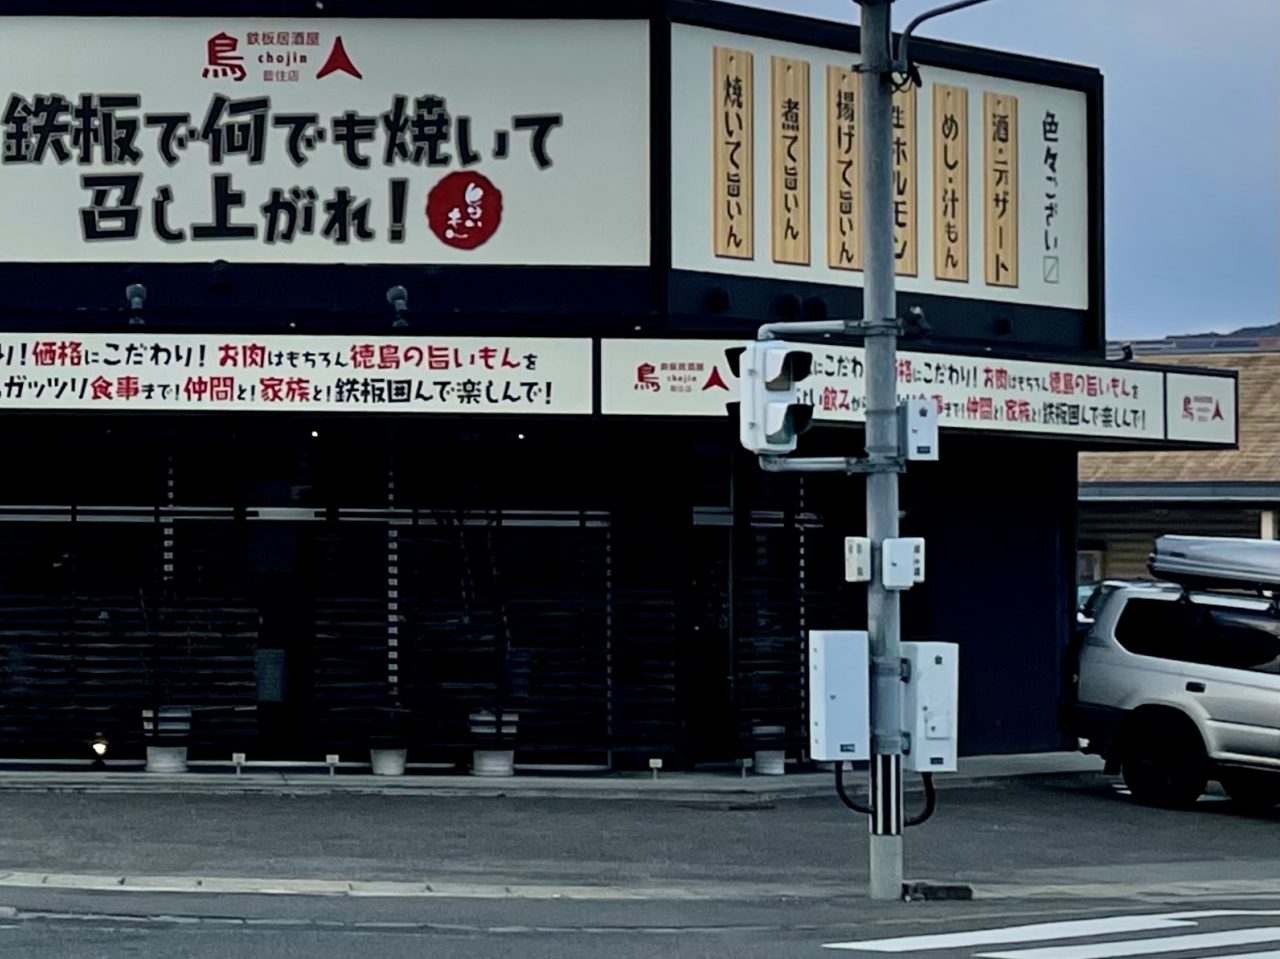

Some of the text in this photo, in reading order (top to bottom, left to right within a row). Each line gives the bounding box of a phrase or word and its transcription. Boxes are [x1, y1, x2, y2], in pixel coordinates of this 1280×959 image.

[246, 32, 320, 46] 鉄板居酒屋
[258, 51, 308, 67] chojin
[2, 93, 563, 169] 鉄板で何でも焼いて
[723, 74, 744, 249] 焼いて旨いん
[780, 97, 800, 241] 煮て旨いん
[80, 172, 410, 243] 召し上がれ!
[836, 89, 856, 265] 揚げて旨いん
